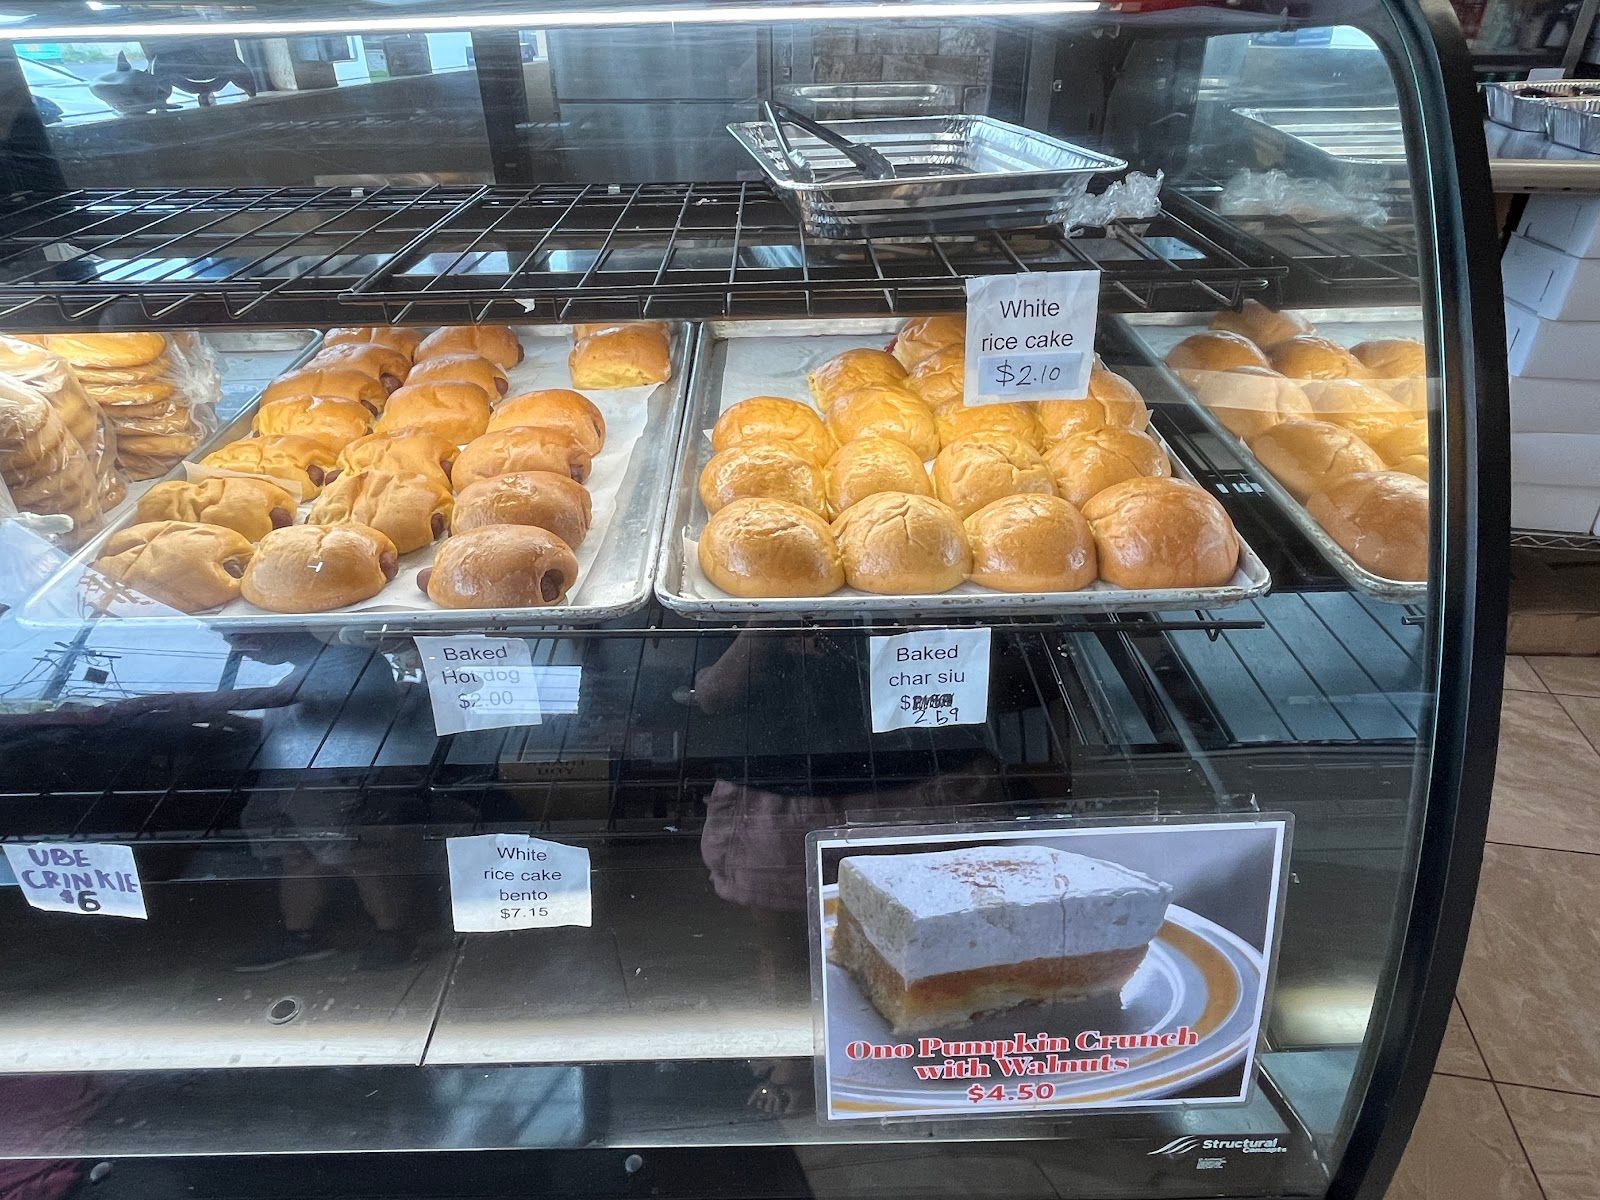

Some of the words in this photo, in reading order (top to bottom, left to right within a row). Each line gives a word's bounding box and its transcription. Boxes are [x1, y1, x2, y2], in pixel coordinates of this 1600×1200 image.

[1000, 298, 1060, 319] White
[982, 333, 1018, 351] rice
[1025, 330, 1074, 349] cake
[995, 359, 1061, 387] $2.10
[443, 646, 508, 661] Baked
[896, 645, 959, 662] Baked
[442, 670, 478, 685] Hot
[483, 669, 520, 684] dog
[889, 672, 932, 687] char
[937, 669, 965, 683] siu
[458, 690, 514, 710] $2.00
[912, 707, 959, 725] 2.59
[27, 848, 91, 868] UBE
[497, 847, 548, 862] White
[484, 867, 515, 881] rice
[521, 869, 562, 882] cake
[499, 889, 548, 901] bento
[500, 907, 549, 920] $7.15
[846, 1040, 914, 1060] Ono
[918, 1032, 1070, 1059] Pumpkin
[1075, 1026, 1199, 1051] Crunch
[913, 1058, 991, 1080] with
[992, 1054, 1129, 1077] Walnuts
[968, 1082, 1055, 1103] $4.50
[1202, 1138, 1278, 1149] Structural
